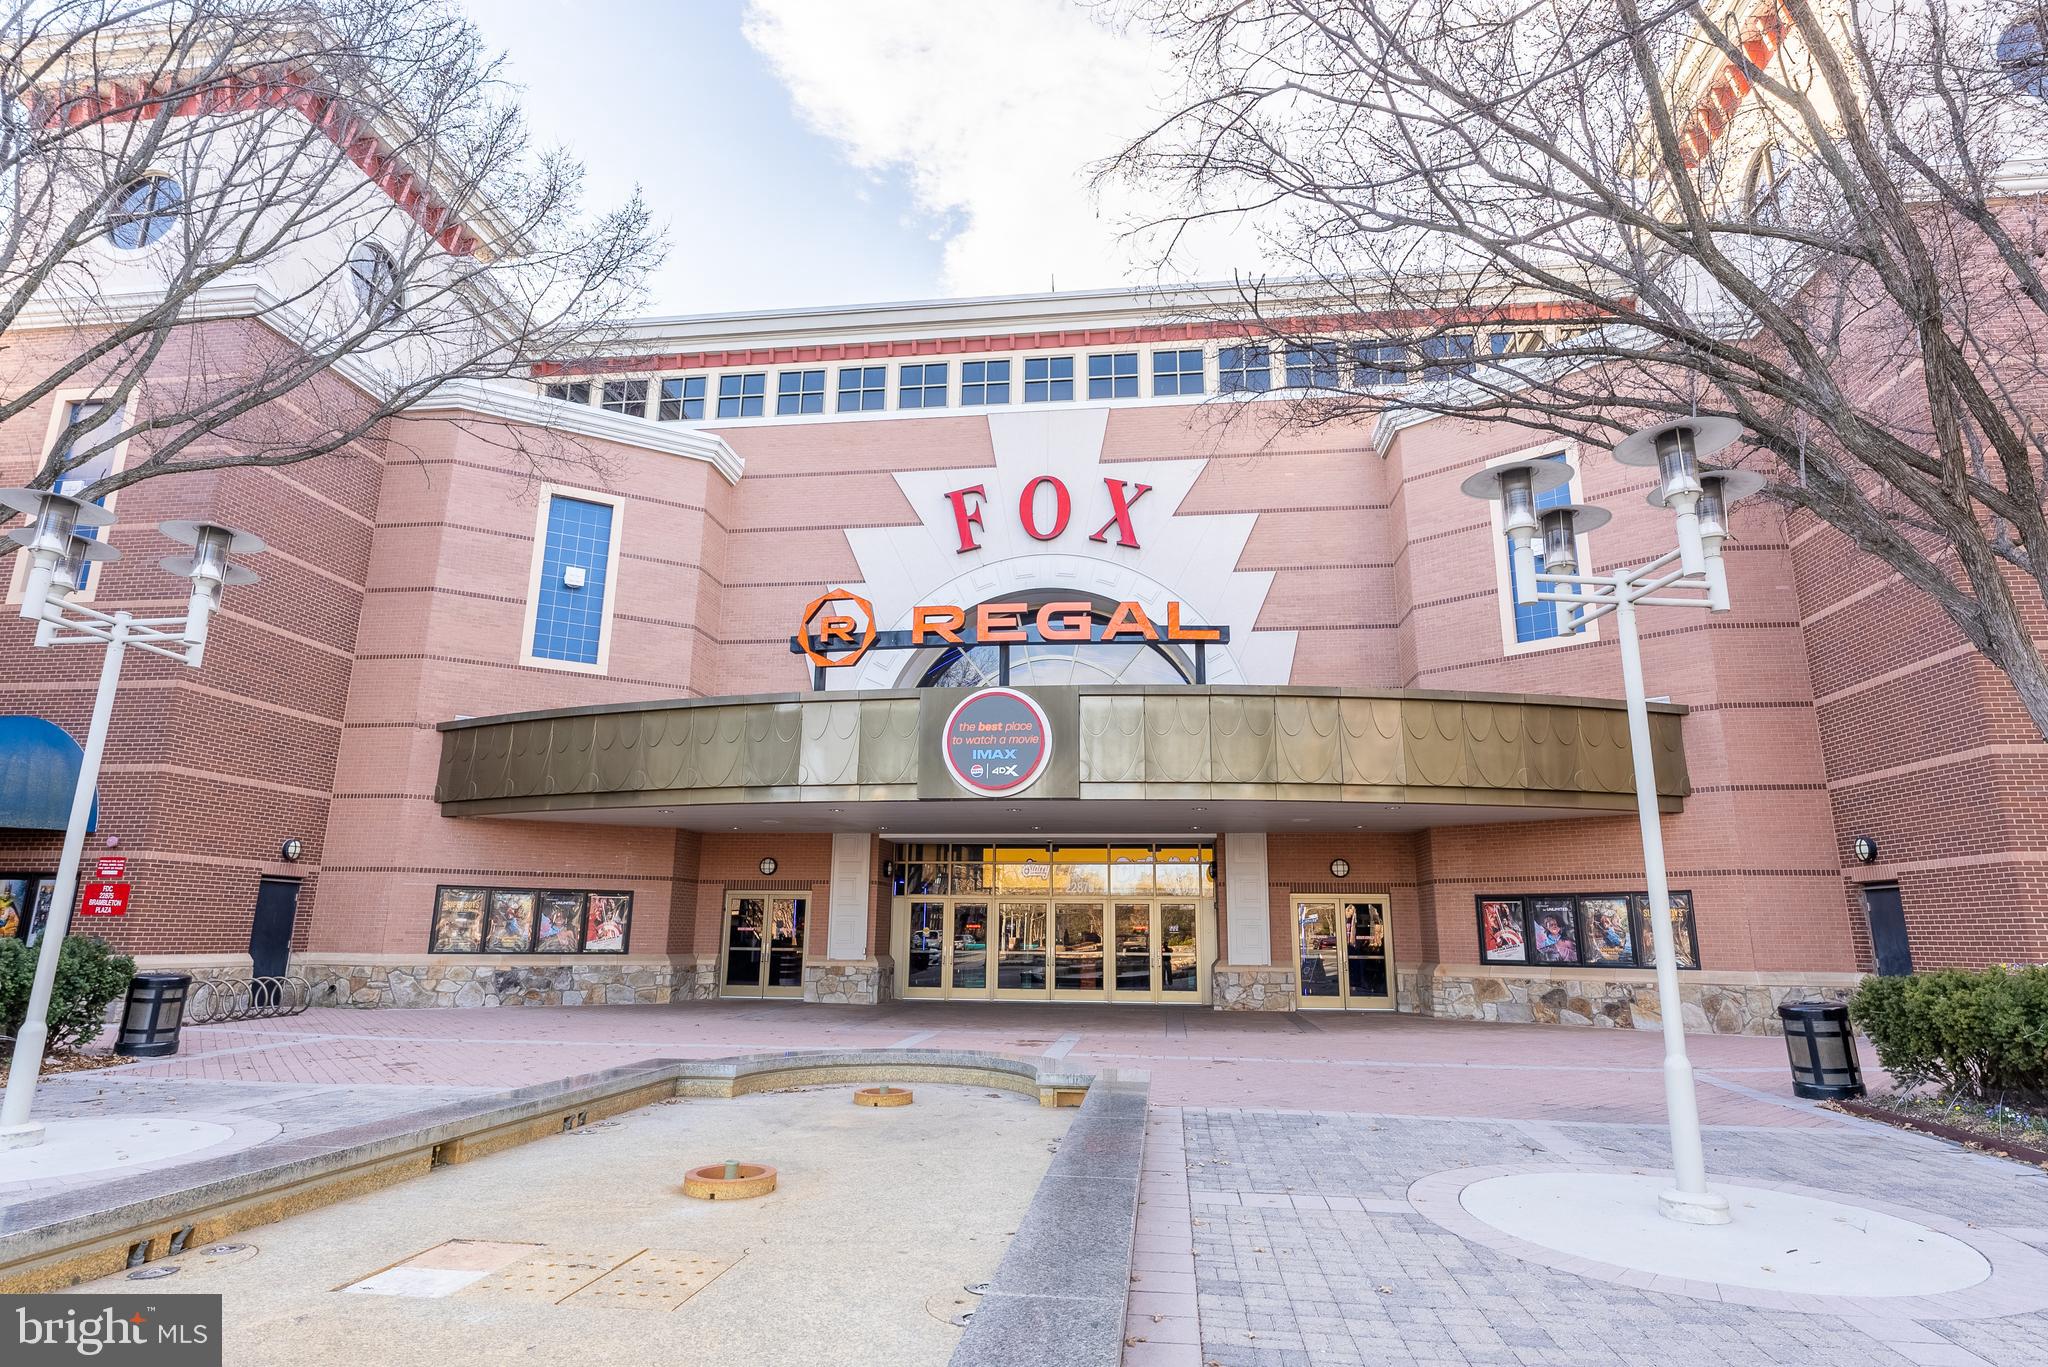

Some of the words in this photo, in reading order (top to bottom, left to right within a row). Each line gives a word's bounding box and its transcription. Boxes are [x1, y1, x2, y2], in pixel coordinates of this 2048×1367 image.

[944, 475, 1152, 554] FOX
[911, 601, 1221, 645] REGAL
[820, 615, 858, 645] R
[959, 721, 976, 732] the
[978, 721, 1003, 732] best
[1005, 721, 1033, 734] place
[952, 735, 963, 745] to
[966, 734, 997, 745] watch
[999, 736, 1006, 745] a
[1008, 734, 1040, 745] movie
[972, 749, 1017, 760] IMAX
[991, 764, 1020, 777] 4DX
[88, 898, 122, 906] BRAMBLETON
